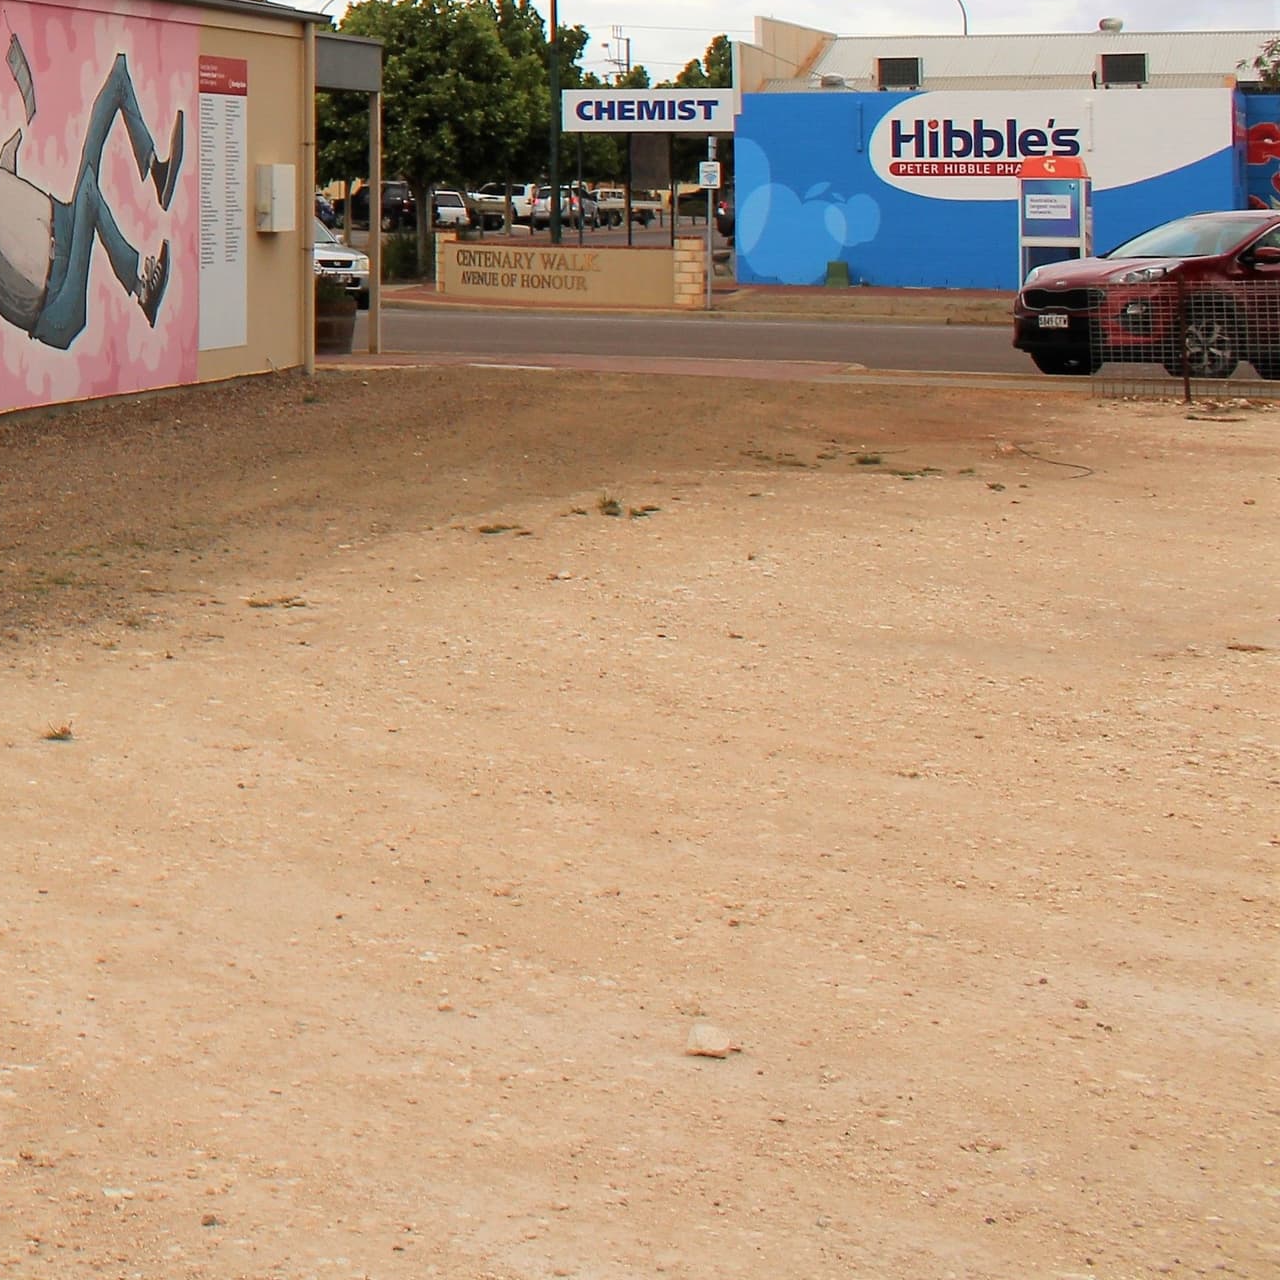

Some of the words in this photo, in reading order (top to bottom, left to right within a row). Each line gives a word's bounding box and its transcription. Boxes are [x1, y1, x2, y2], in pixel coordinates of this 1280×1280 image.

[576, 100, 719, 121] CHEMIST
[891, 119, 1080, 158] Hibble's
[899, 163, 939, 174] PETER
[944, 163, 991, 174] HIBBLE
[456, 249, 536, 269] CENTENARY
[540, 252, 601, 272] WALK
[461, 271, 499, 287] AVENUE
[501, 272, 517, 287] OF
[521, 274, 588, 291] HONOUR
